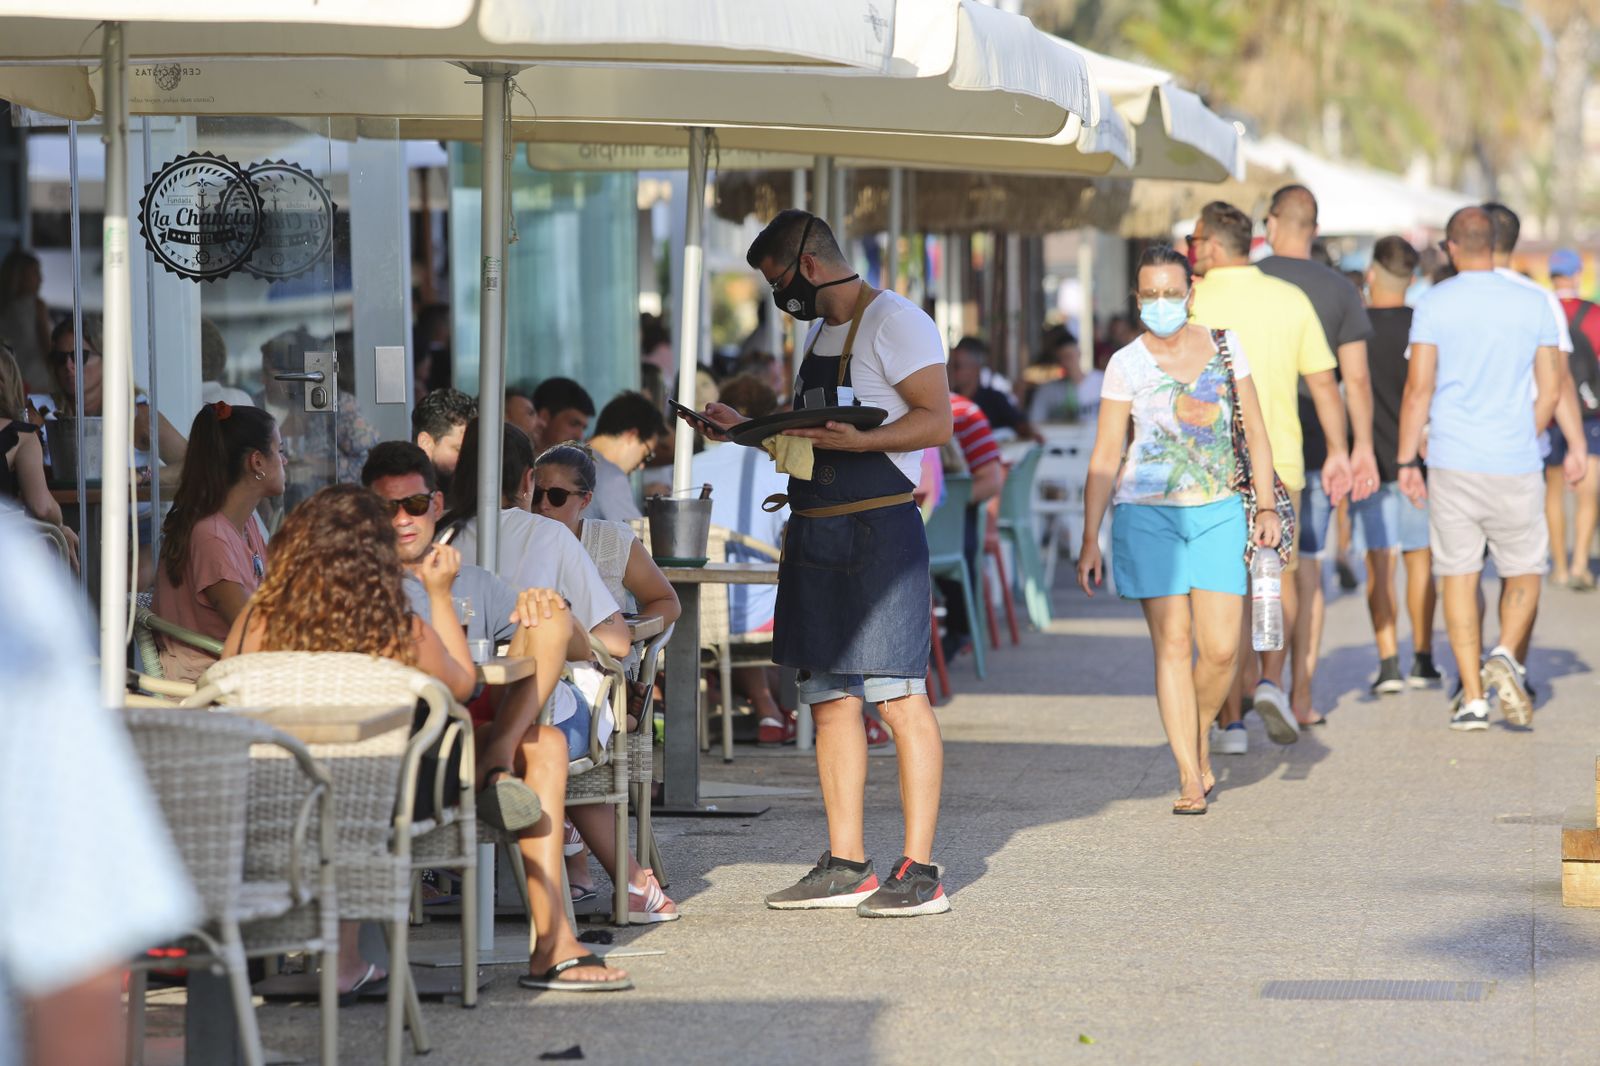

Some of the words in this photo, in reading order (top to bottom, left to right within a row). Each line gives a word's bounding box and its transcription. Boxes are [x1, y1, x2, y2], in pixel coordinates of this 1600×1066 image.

[152, 210, 171, 231] La
[176, 207, 253, 227] Chancla
[190, 232, 216, 244] HOTEL
